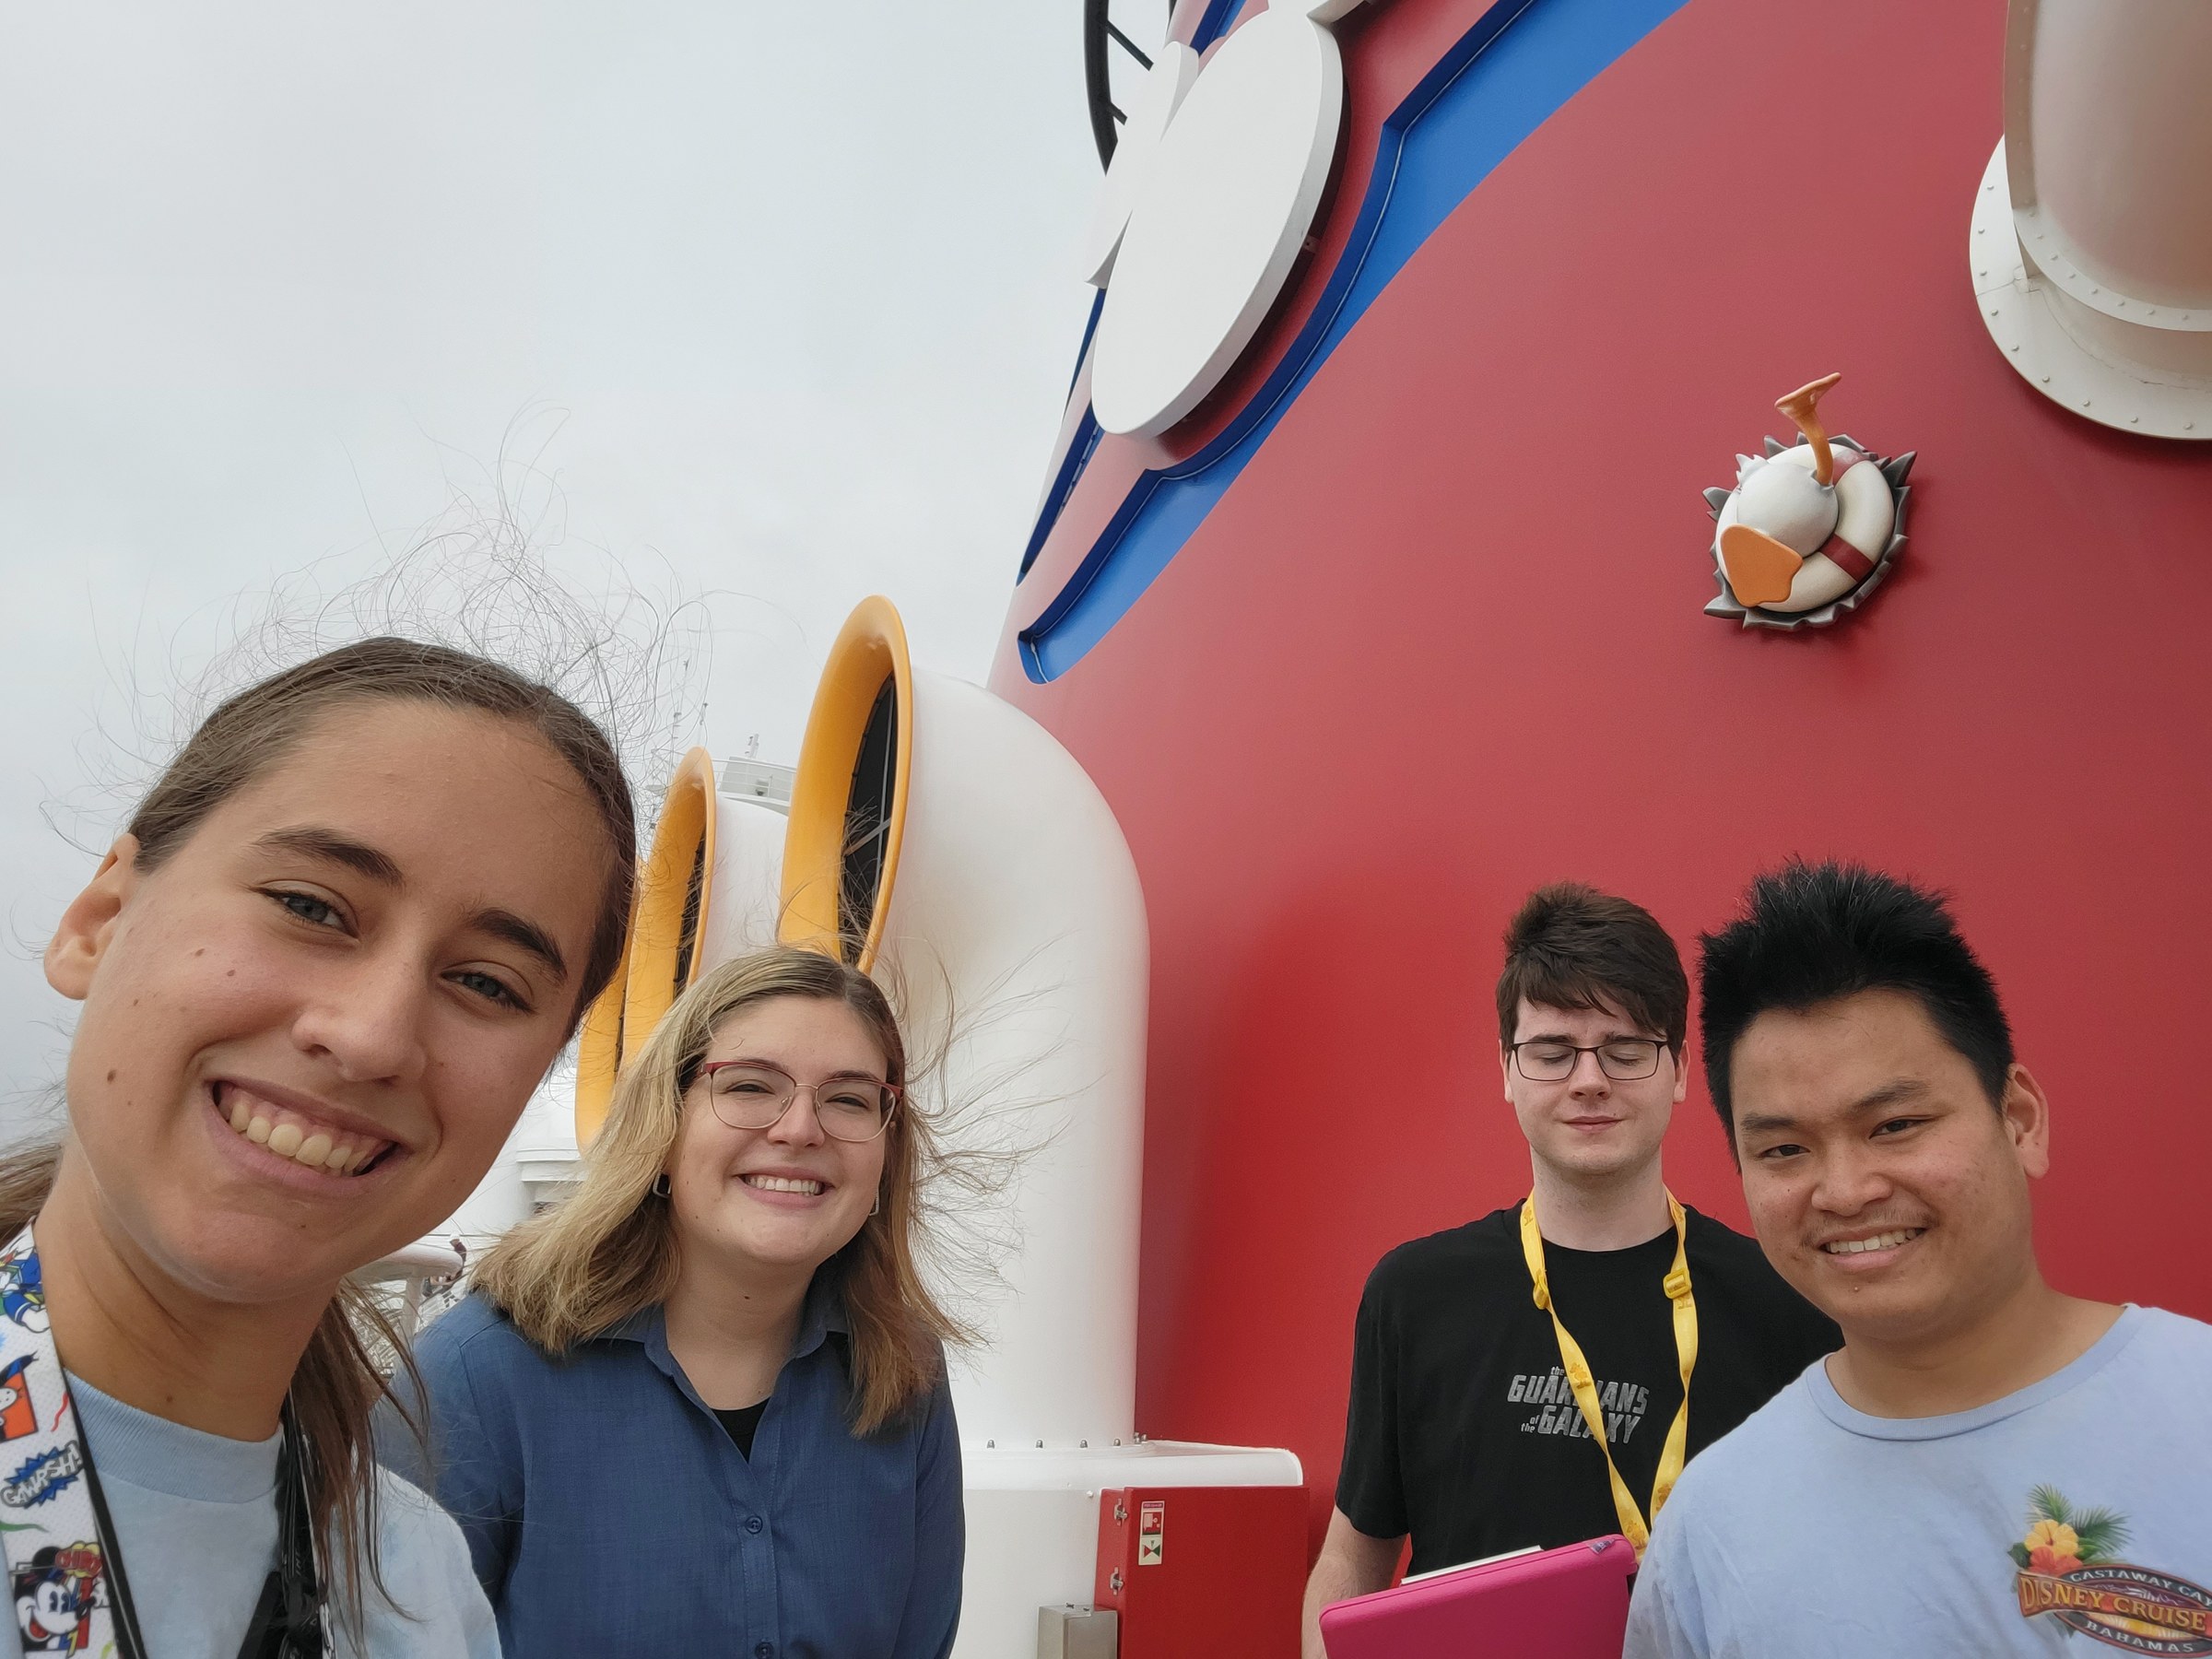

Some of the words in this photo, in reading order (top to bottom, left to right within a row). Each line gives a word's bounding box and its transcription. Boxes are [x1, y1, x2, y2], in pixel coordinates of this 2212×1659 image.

[1550, 1366, 1565, 1375] the
[1521, 1422, 1535, 1433] the
[1529, 1414, 1540, 1425] of
[1537, 1405, 1641, 1443] GALXY
[2, 1442, 83, 1506] GAWRSH!
[2070, 1570, 2173, 1589] CASTAWAY
[2019, 1577, 2105, 1609] DISNEY
[2112, 1596, 2206, 1631] CRUISE
[2086, 1620, 2194, 1653] BAHAMAS
